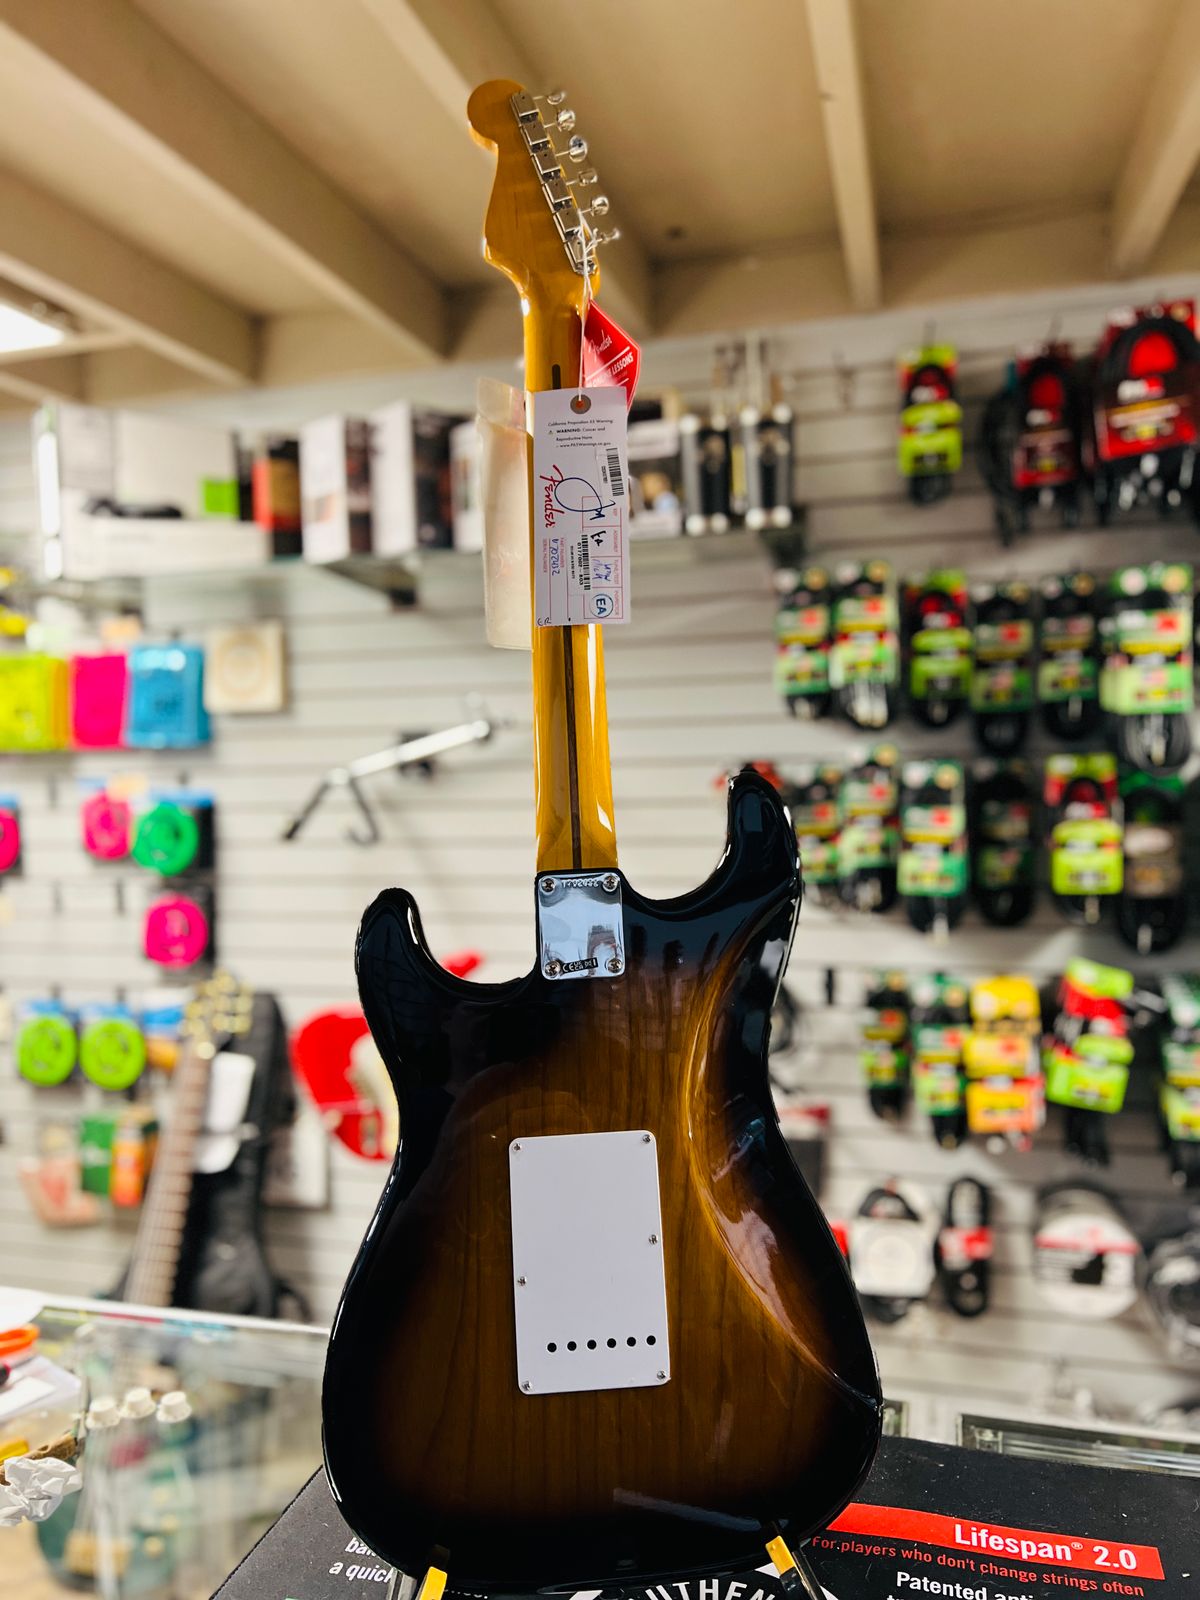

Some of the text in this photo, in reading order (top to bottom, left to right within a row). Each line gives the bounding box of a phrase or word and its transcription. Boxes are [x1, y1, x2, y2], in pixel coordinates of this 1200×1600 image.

[611, 351, 634, 376] LESSONS
[539, 464, 565, 528] Fender
[595, 598, 607, 615] EA
[328, 1562, 344, 1575] a
[812, 1536, 1145, 1597] For players who don't change strings often
[1092, 1546, 1137, 1570] 2.0
[896, 1571, 987, 1600] Patented
